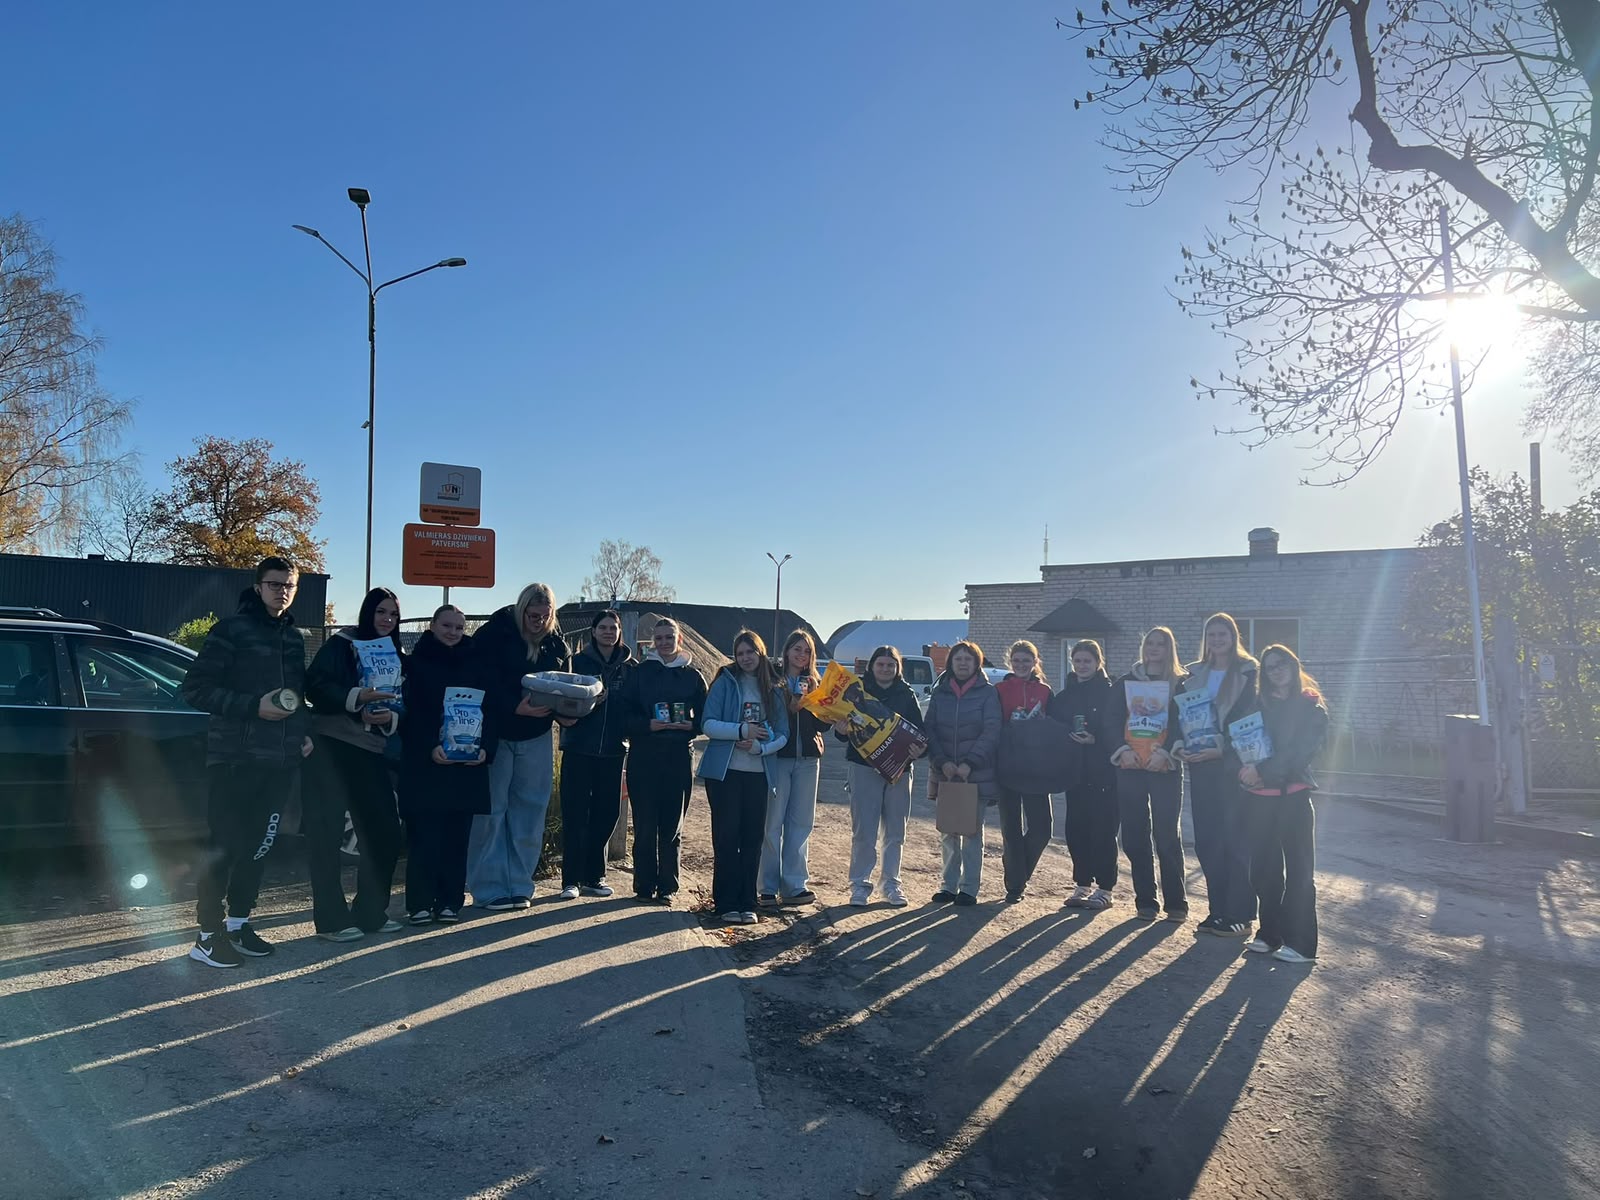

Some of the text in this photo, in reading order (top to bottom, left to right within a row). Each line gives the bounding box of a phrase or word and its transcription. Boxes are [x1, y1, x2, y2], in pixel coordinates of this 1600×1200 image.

[414, 531, 452, 540] VALMIERAS
[431, 540, 470, 549] PATVERSME
[377, 665, 394, 675] line
[458, 716, 475, 726] line
[1141, 717, 1147, 727] 4
[870, 737, 894, 760] REGULAR
[253, 813, 280, 860] adidas
